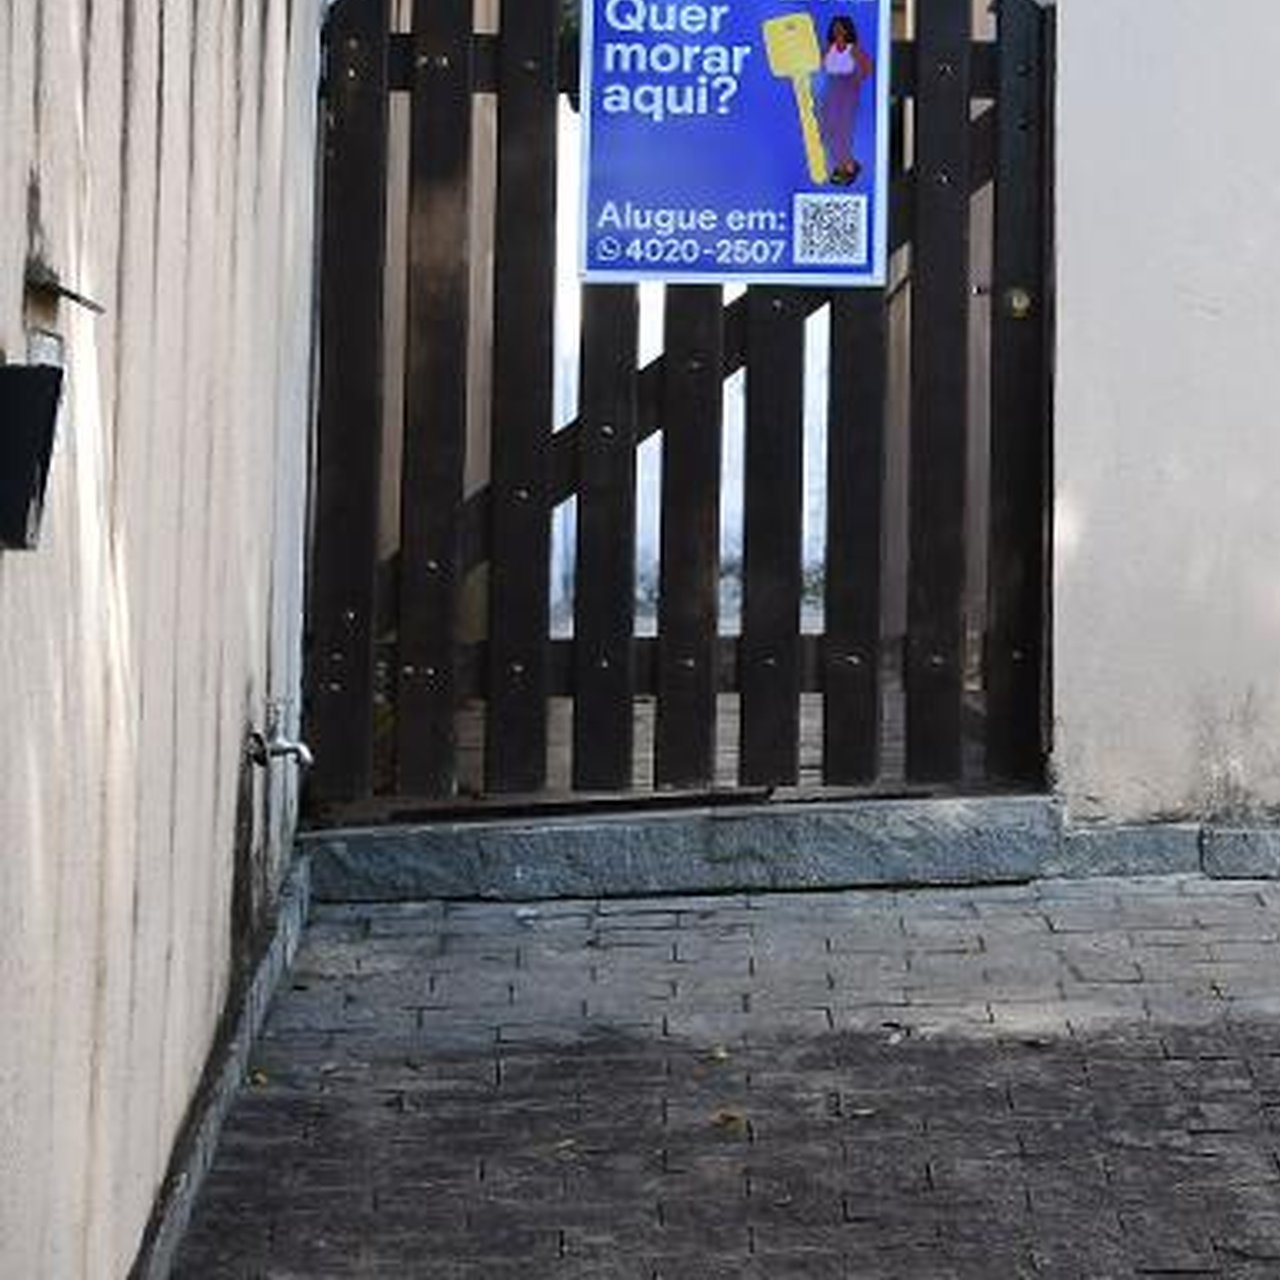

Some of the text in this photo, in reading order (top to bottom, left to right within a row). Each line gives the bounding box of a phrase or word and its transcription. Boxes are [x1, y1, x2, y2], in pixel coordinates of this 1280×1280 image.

[603, 41, 751, 75] morar
[602, 76, 738, 121] aqui?
[597, 200, 787, 236] Alugue em:
[625, 239, 786, 264] 4020-2507
